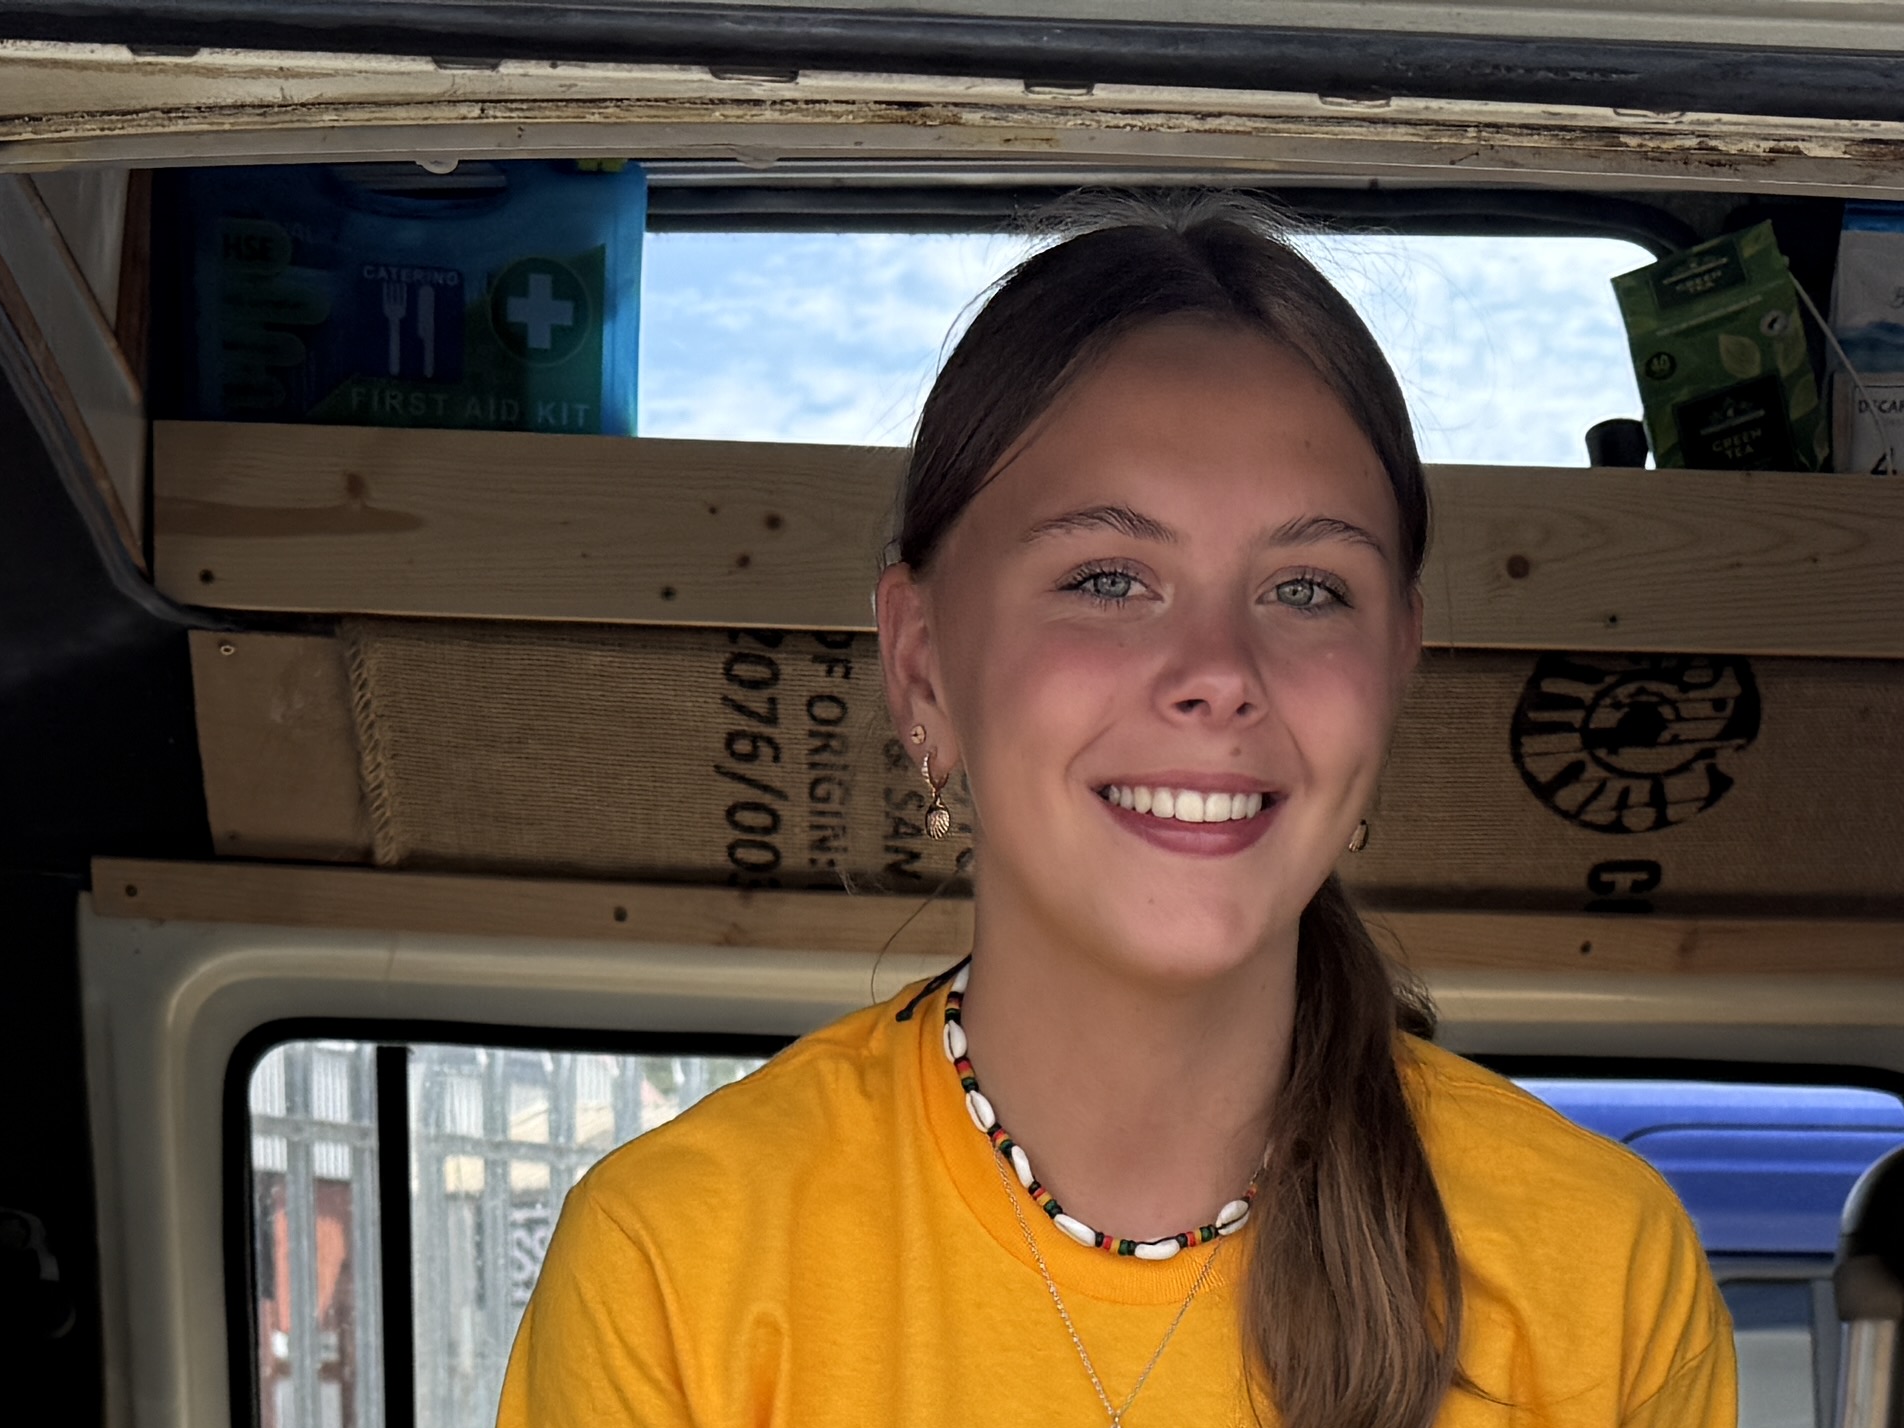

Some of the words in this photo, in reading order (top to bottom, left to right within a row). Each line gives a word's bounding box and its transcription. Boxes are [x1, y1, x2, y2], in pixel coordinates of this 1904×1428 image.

[362, 264, 460, 288] CATERING
[349, 389, 449, 418] FIRST
[464, 395, 521, 424] AID
[535, 400, 591, 428] KIT
